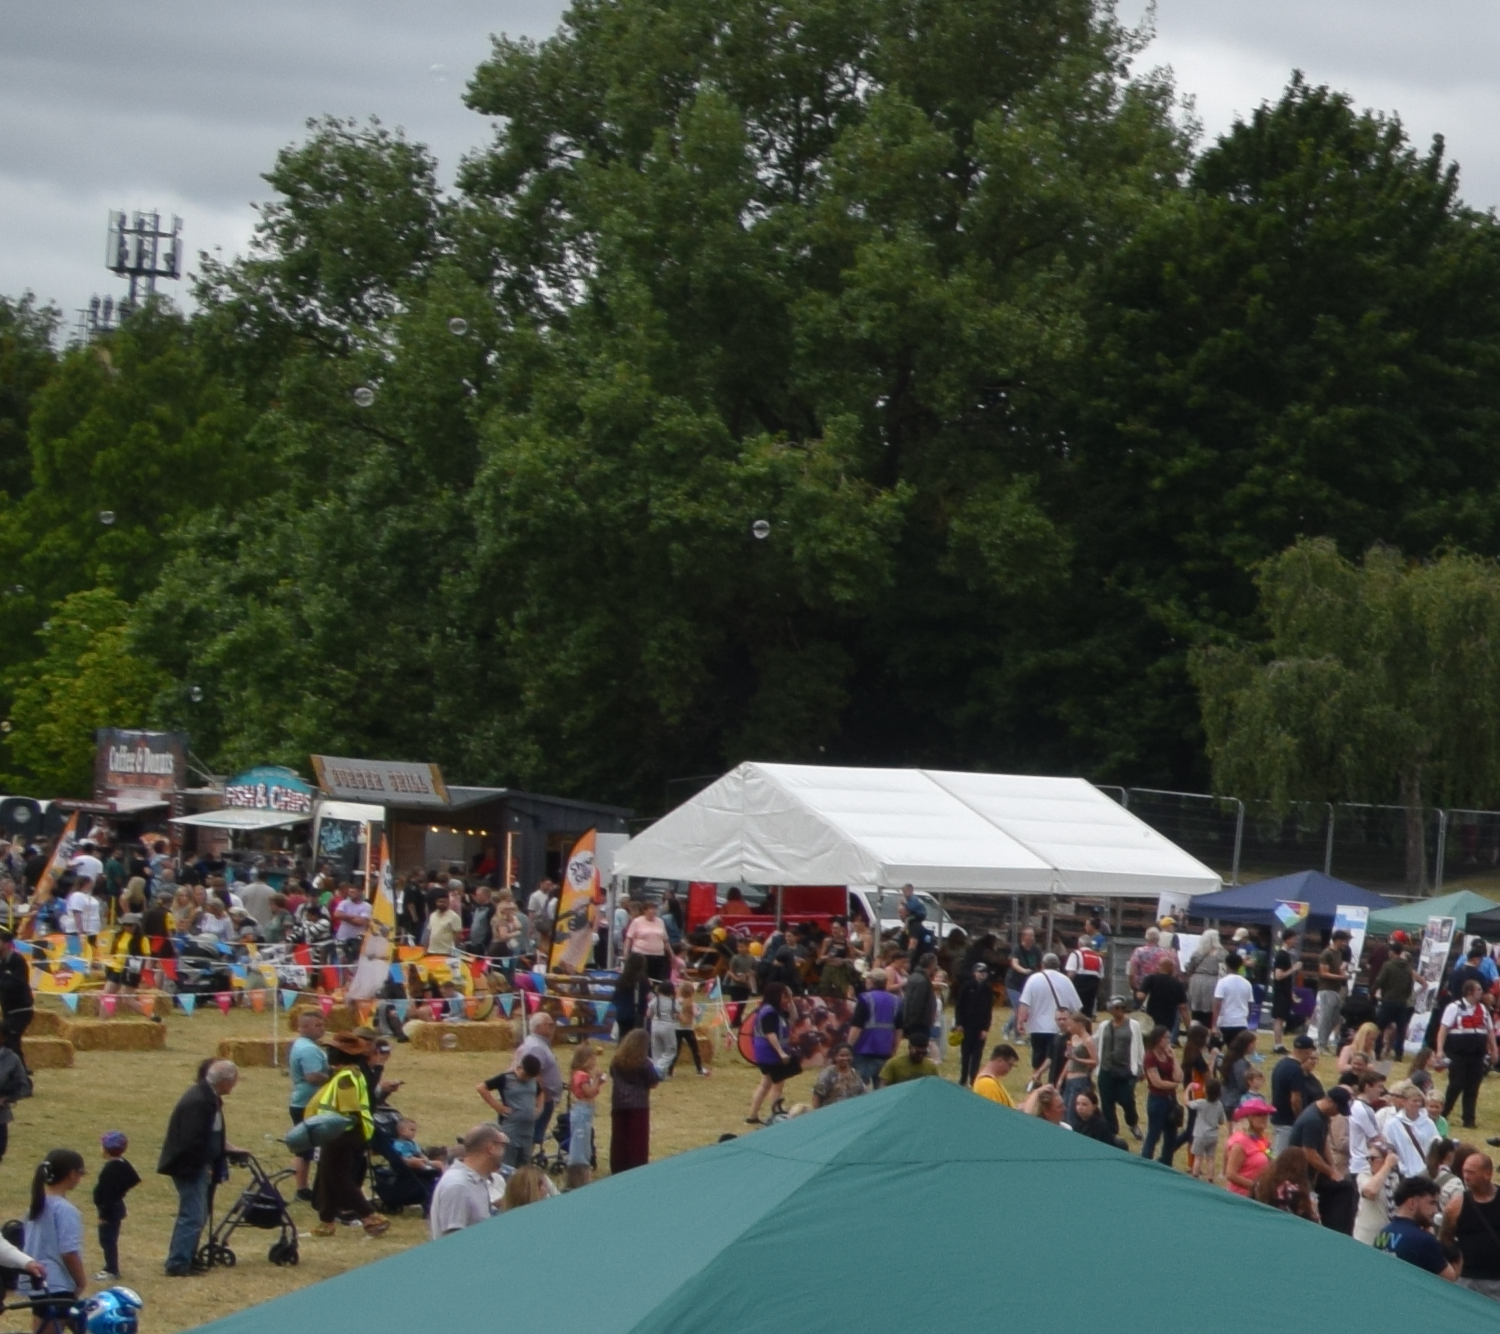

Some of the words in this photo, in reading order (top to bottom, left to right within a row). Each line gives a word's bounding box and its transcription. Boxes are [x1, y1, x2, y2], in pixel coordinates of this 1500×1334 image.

[226, 784, 256, 807] FISH
[256, 783, 267, 808] &
[270, 785, 312, 813] CHIPS
